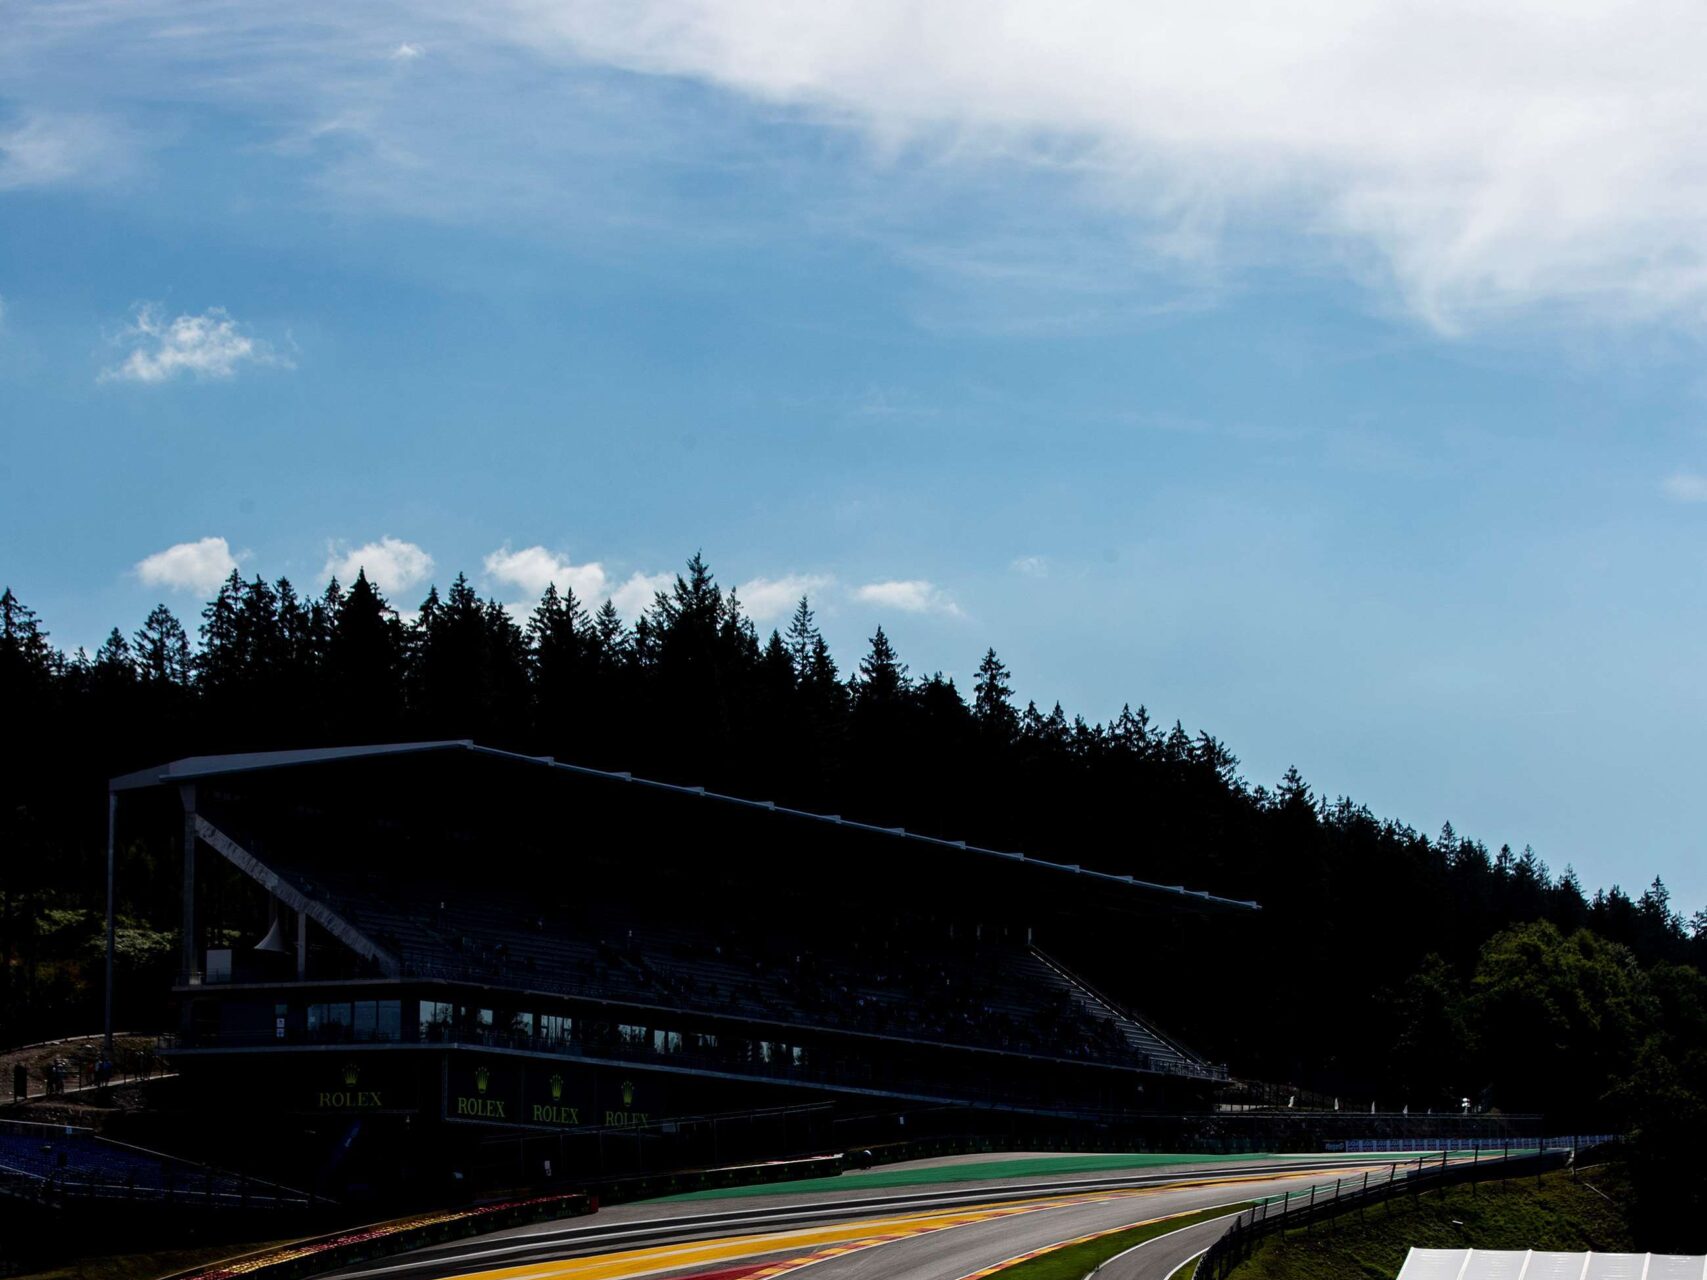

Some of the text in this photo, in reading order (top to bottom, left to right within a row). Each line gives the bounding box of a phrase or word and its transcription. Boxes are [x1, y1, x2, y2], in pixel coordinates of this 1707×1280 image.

[319, 1091, 383, 1108] ROLEX
[457, 1097, 506, 1117] ROLEX
[533, 1104, 579, 1125] ROLEX
[606, 1110, 649, 1128] ROLEX
